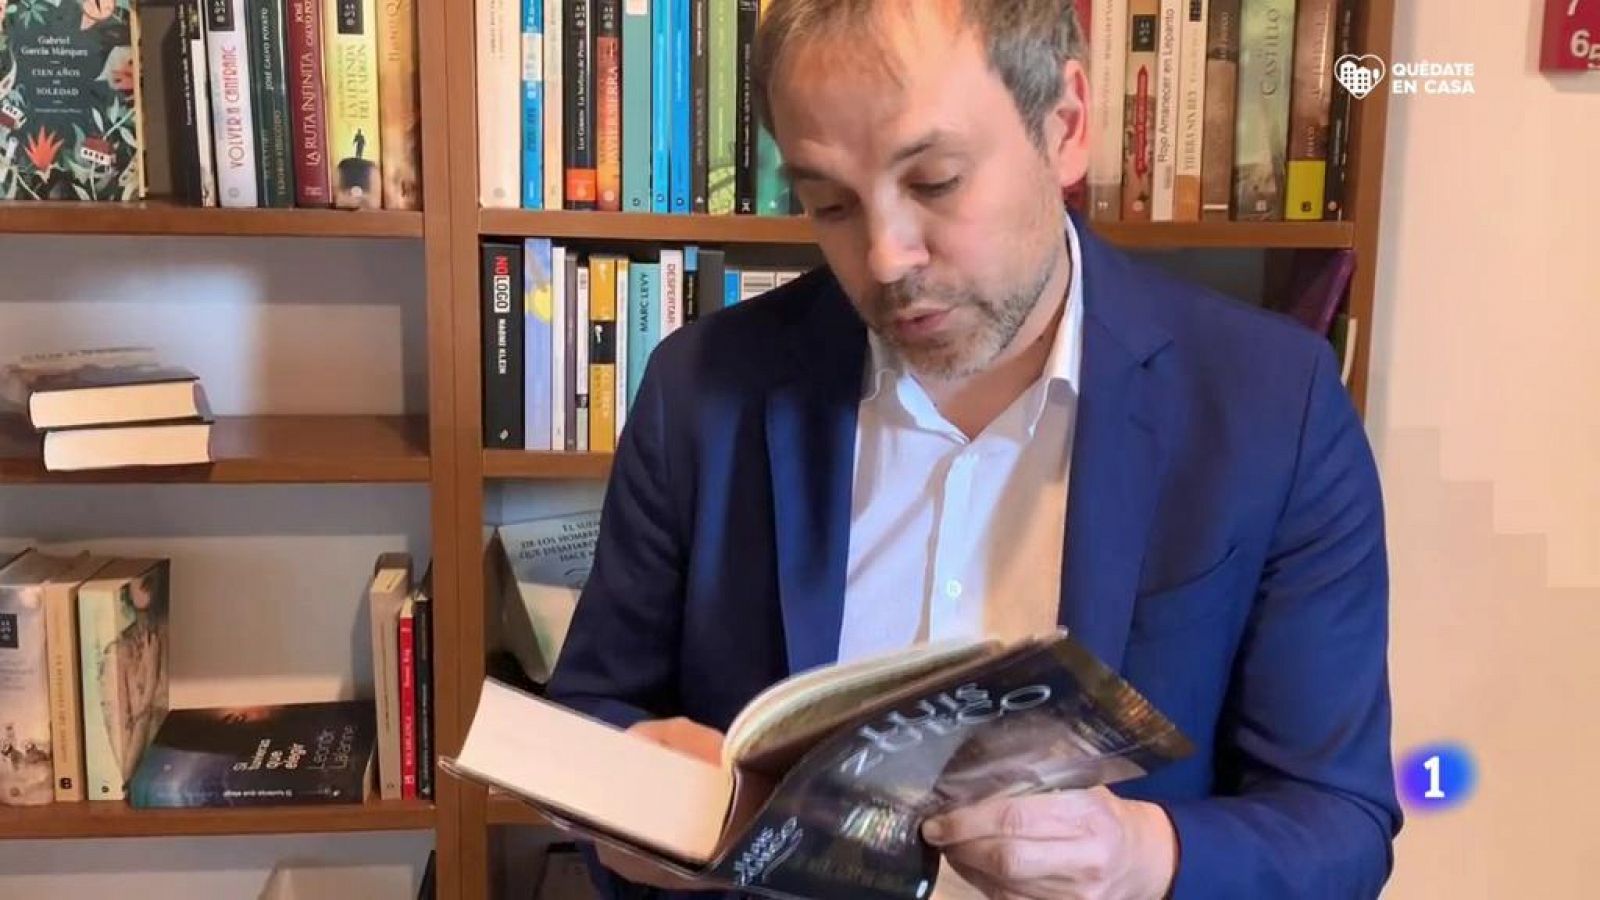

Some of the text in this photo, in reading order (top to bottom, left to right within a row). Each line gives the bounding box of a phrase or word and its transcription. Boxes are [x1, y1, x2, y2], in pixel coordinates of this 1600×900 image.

[21, 46, 88, 58] García Márquez
[37, 36, 70, 45] Gabriel
[1162, 9, 1176, 56] Lepanto
[1259, 8, 1278, 96] CASTILLO
[32, 66, 81, 77] CIEN AÑOS
[1161, 59, 1171, 73] en
[36, 87, 79, 96] SOLEDAD
[301, 53, 320, 166] LA RUTA INFINITA
[1158, 77, 1170, 134] Amanecer
[226, 119, 245, 169] VOLVER
[1157, 137, 1170, 162] Rojo
[495, 255, 509, 311] NO LOGO
[638, 272, 649, 333] MARC LEVY
[666, 263, 677, 326] DESPERTAR
[498, 318, 507, 375] NAOMI KLEIN
